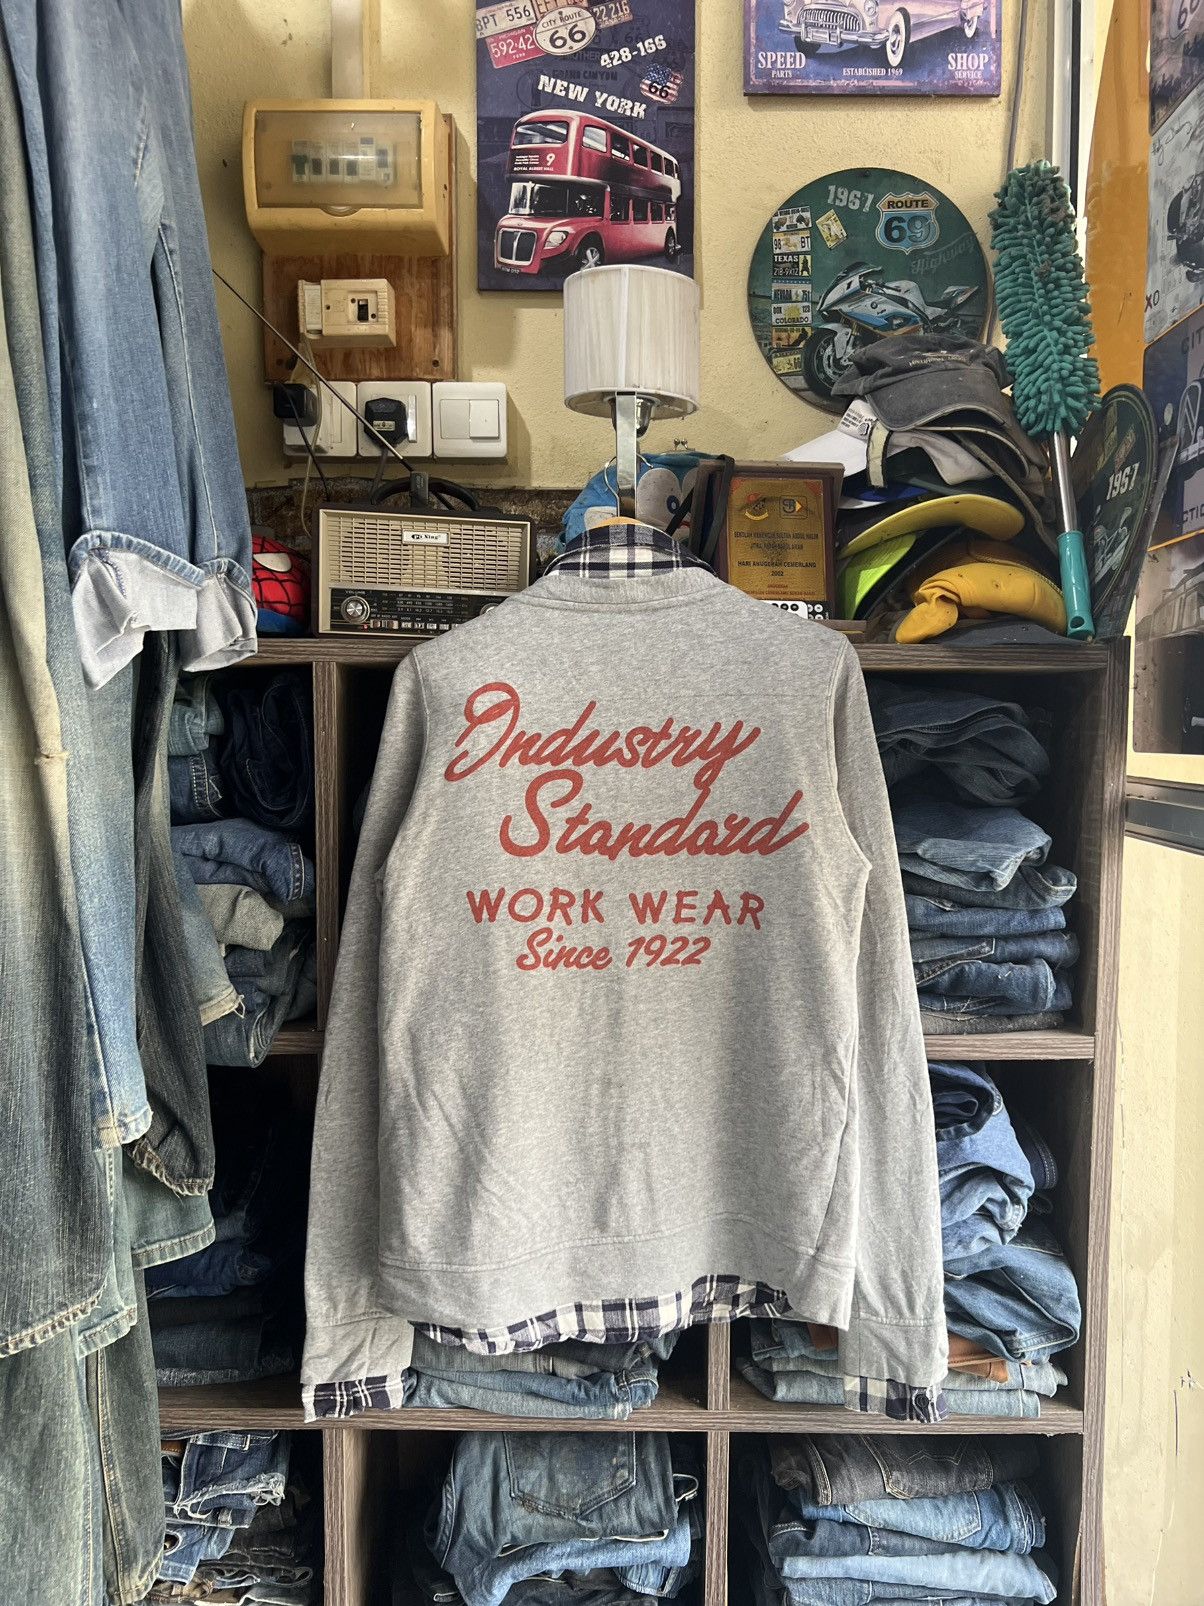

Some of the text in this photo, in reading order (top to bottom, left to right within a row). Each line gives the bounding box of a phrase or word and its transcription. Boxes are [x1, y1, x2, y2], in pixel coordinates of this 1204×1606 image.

[506, 5, 531, 22] 556
[541, 11, 582, 28] CITY ROUTE
[549, 24, 586, 49] 66
[600, 34, 667, 69] 428-166
[758, 51, 989, 70] SPEED SHOP
[771, 70, 792, 78] PARTS
[842, 67, 903, 77] ESTABLISHED 1969
[954, 70, 982, 79] SERVICE
[537, 74, 647, 119] NEW YORK
[649, 81, 670, 99] 66
[546, 153, 556, 166] 9
[827, 184, 875, 213] 1967
[887, 199, 929, 210] ROUTE
[884, 215, 931, 244] 69
[775, 316, 809, 324] COLORADO
[1106, 461, 1141, 501] 1967
[444, 681, 761, 790] Industry
[500, 768, 810, 860] Standard
[466, 887, 765, 930] WORK WEAR
[516, 926, 712, 971] Since 1922
